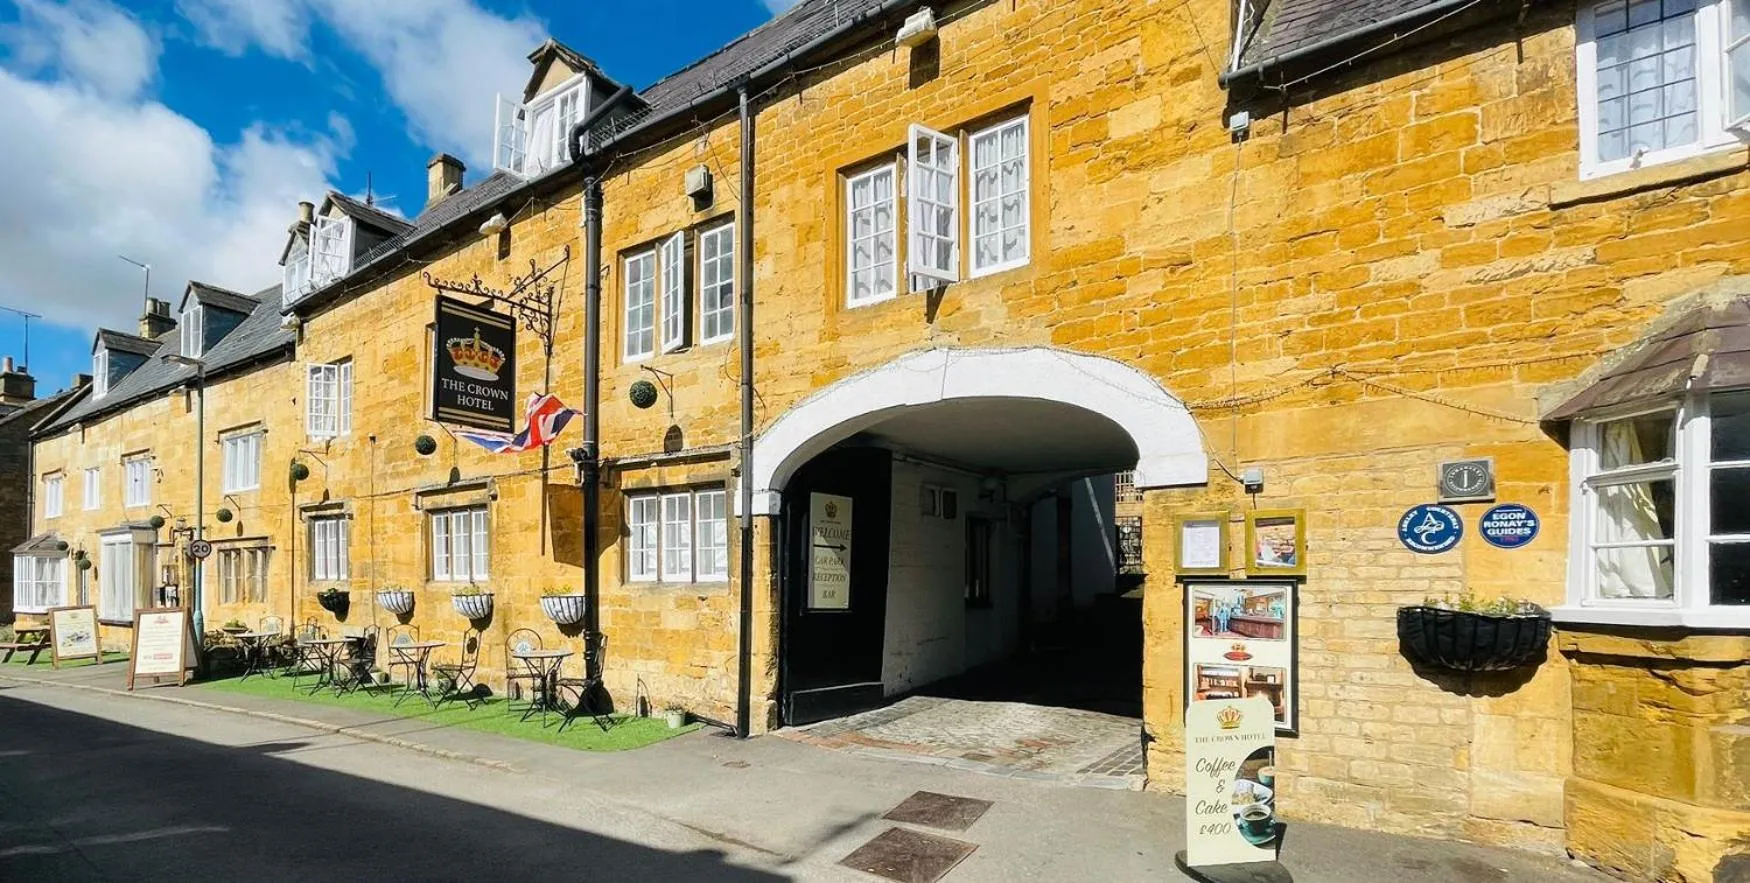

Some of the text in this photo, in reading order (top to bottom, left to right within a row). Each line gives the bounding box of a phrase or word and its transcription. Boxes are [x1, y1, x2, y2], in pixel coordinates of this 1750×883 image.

[441, 377, 509, 401] THE CROWN
[457, 394, 494, 411] HOTEL
[1492, 512, 1526, 520] EGON
[1483, 519, 1535, 528] RONAY'S
[1487, 527, 1532, 535] GUIDES
[193, 544, 208, 554] 20
[1211, 735, 1240, 743] CROWN
[1241, 733, 1266, 741] HOTEL
[1195, 756, 1236, 778] Coffee
[1215, 779, 1226, 794] &
[1195, 799, 1228, 815] Cake
